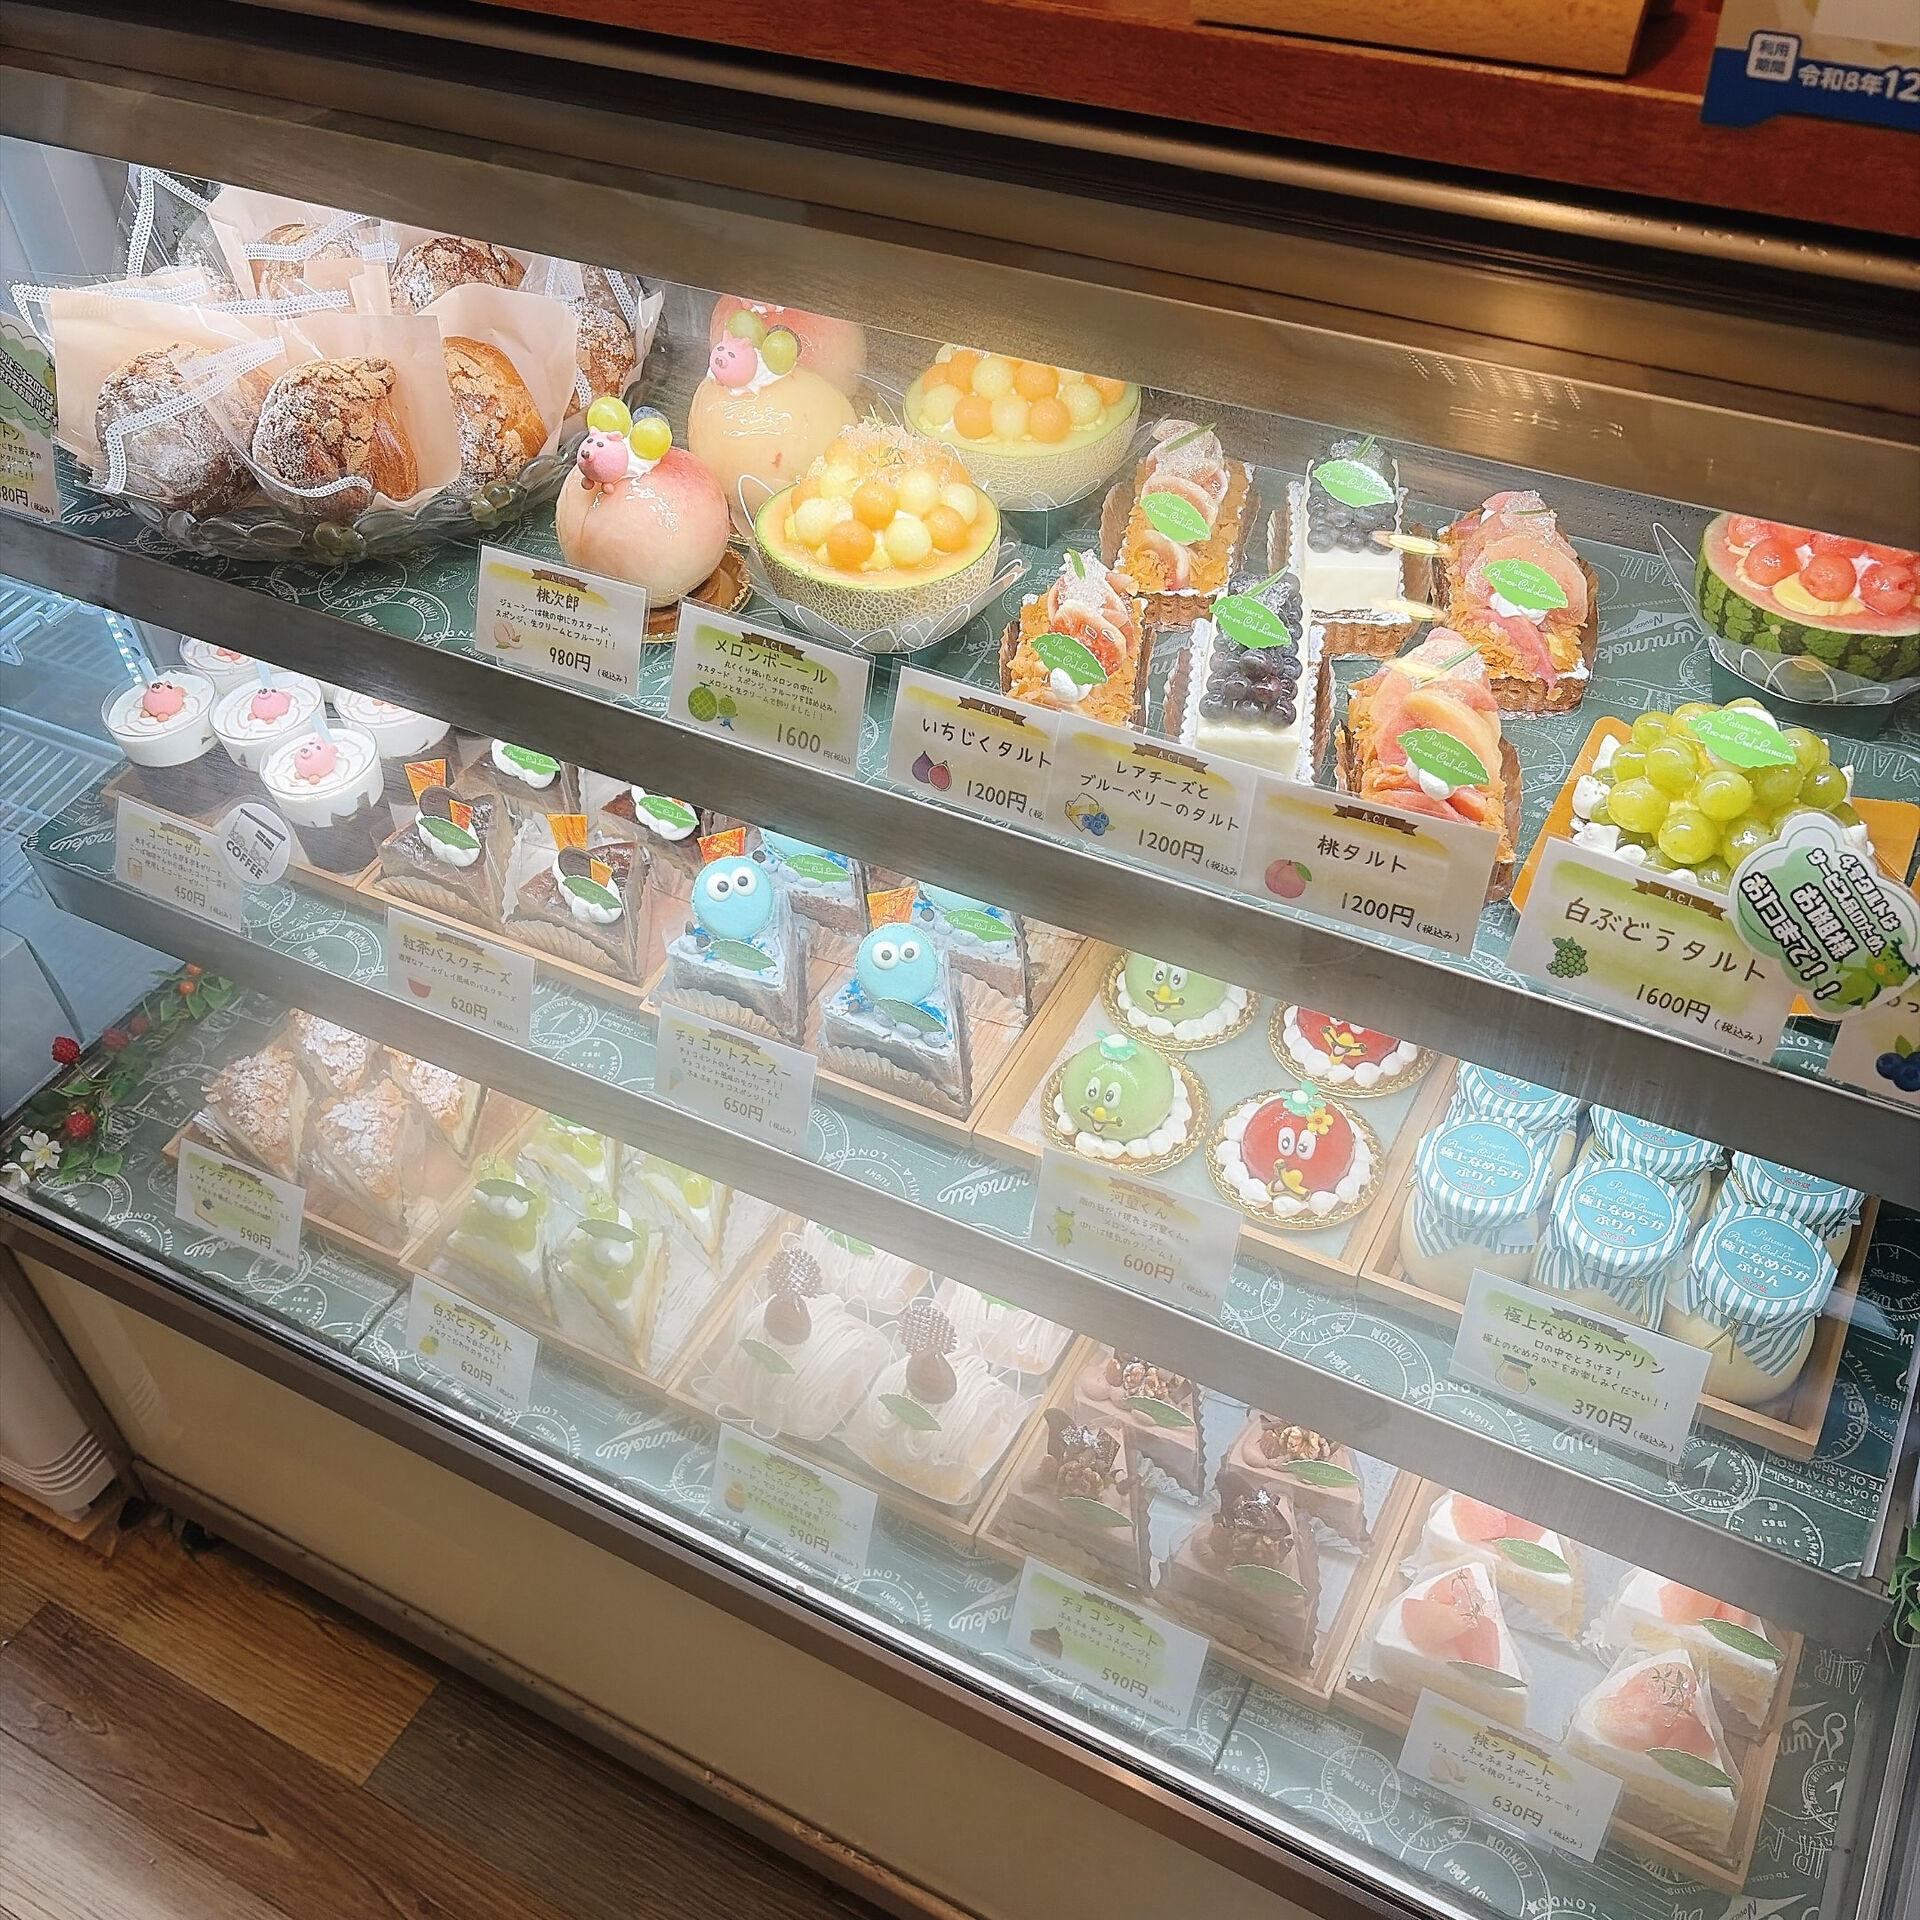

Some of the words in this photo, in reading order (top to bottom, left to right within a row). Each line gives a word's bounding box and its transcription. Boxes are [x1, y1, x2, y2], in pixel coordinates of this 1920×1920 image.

[536, 586, 580, 613] 桃次郎
[549, 647, 592, 673] 980円
[776, 723, 821, 753] 1600
[922, 718, 1052, 768] いちじくタルト
[966, 780, 1027, 814] 1200円
[1116, 761, 1209, 800] レアチーズと
[1080, 774, 1240, 832] ブルーベリーのタルト
[149, 828, 211, 858] コーヒーゼリー
[226, 840, 264, 879] COFFEE
[1139, 829, 1205, 865] 1200円
[1316, 834, 1408, 874] 桃タルト
[174, 885, 206, 908] 450円
[1838, 854, 1900, 932] 4号タルトは
[1340, 892, 1416, 929] 1200円
[1416, 922, 1460, 942] （税込み）
[1564, 897, 1766, 982] 白ぶどうタルト
[402, 934, 513, 985] 紅茶バスクチーズ
[451, 996, 489, 1021] 620円
[1636, 983, 1712, 1024] 1600円
[1714, 1019, 1763, 1045] （税込み）
[675, 1029, 792, 1078] チョコットスースー
[723, 1097, 764, 1123] 650円
[1440, 1146, 1524, 1181] 極上なめらか
[1110, 1190, 1168, 1220] 河童くん
[1579, 1193, 1665, 1231] 極上なめらか
[240, 1227, 272, 1250] 590円
[1123, 1254, 1175, 1285] 600円
[1720, 1238, 1811, 1282] 極上なめらか
[433, 1303, 513, 1353] 白ぶどうタルト
[1503, 1305, 1666, 1375] 極上なめらかプリン
[461, 1361, 493, 1386] 620円
[1534, 1339, 1622, 1380] 口の中でとろける！
[1571, 1399, 1634, 1435] 370円
[789, 1526, 830, 1554] 590円
[1061, 1596, 1159, 1648] チョコショート
[1101, 1667, 1150, 1700] 590円
[1472, 1732, 1556, 1778] 桃ショート
[1492, 1795, 1545, 1829] 630円
